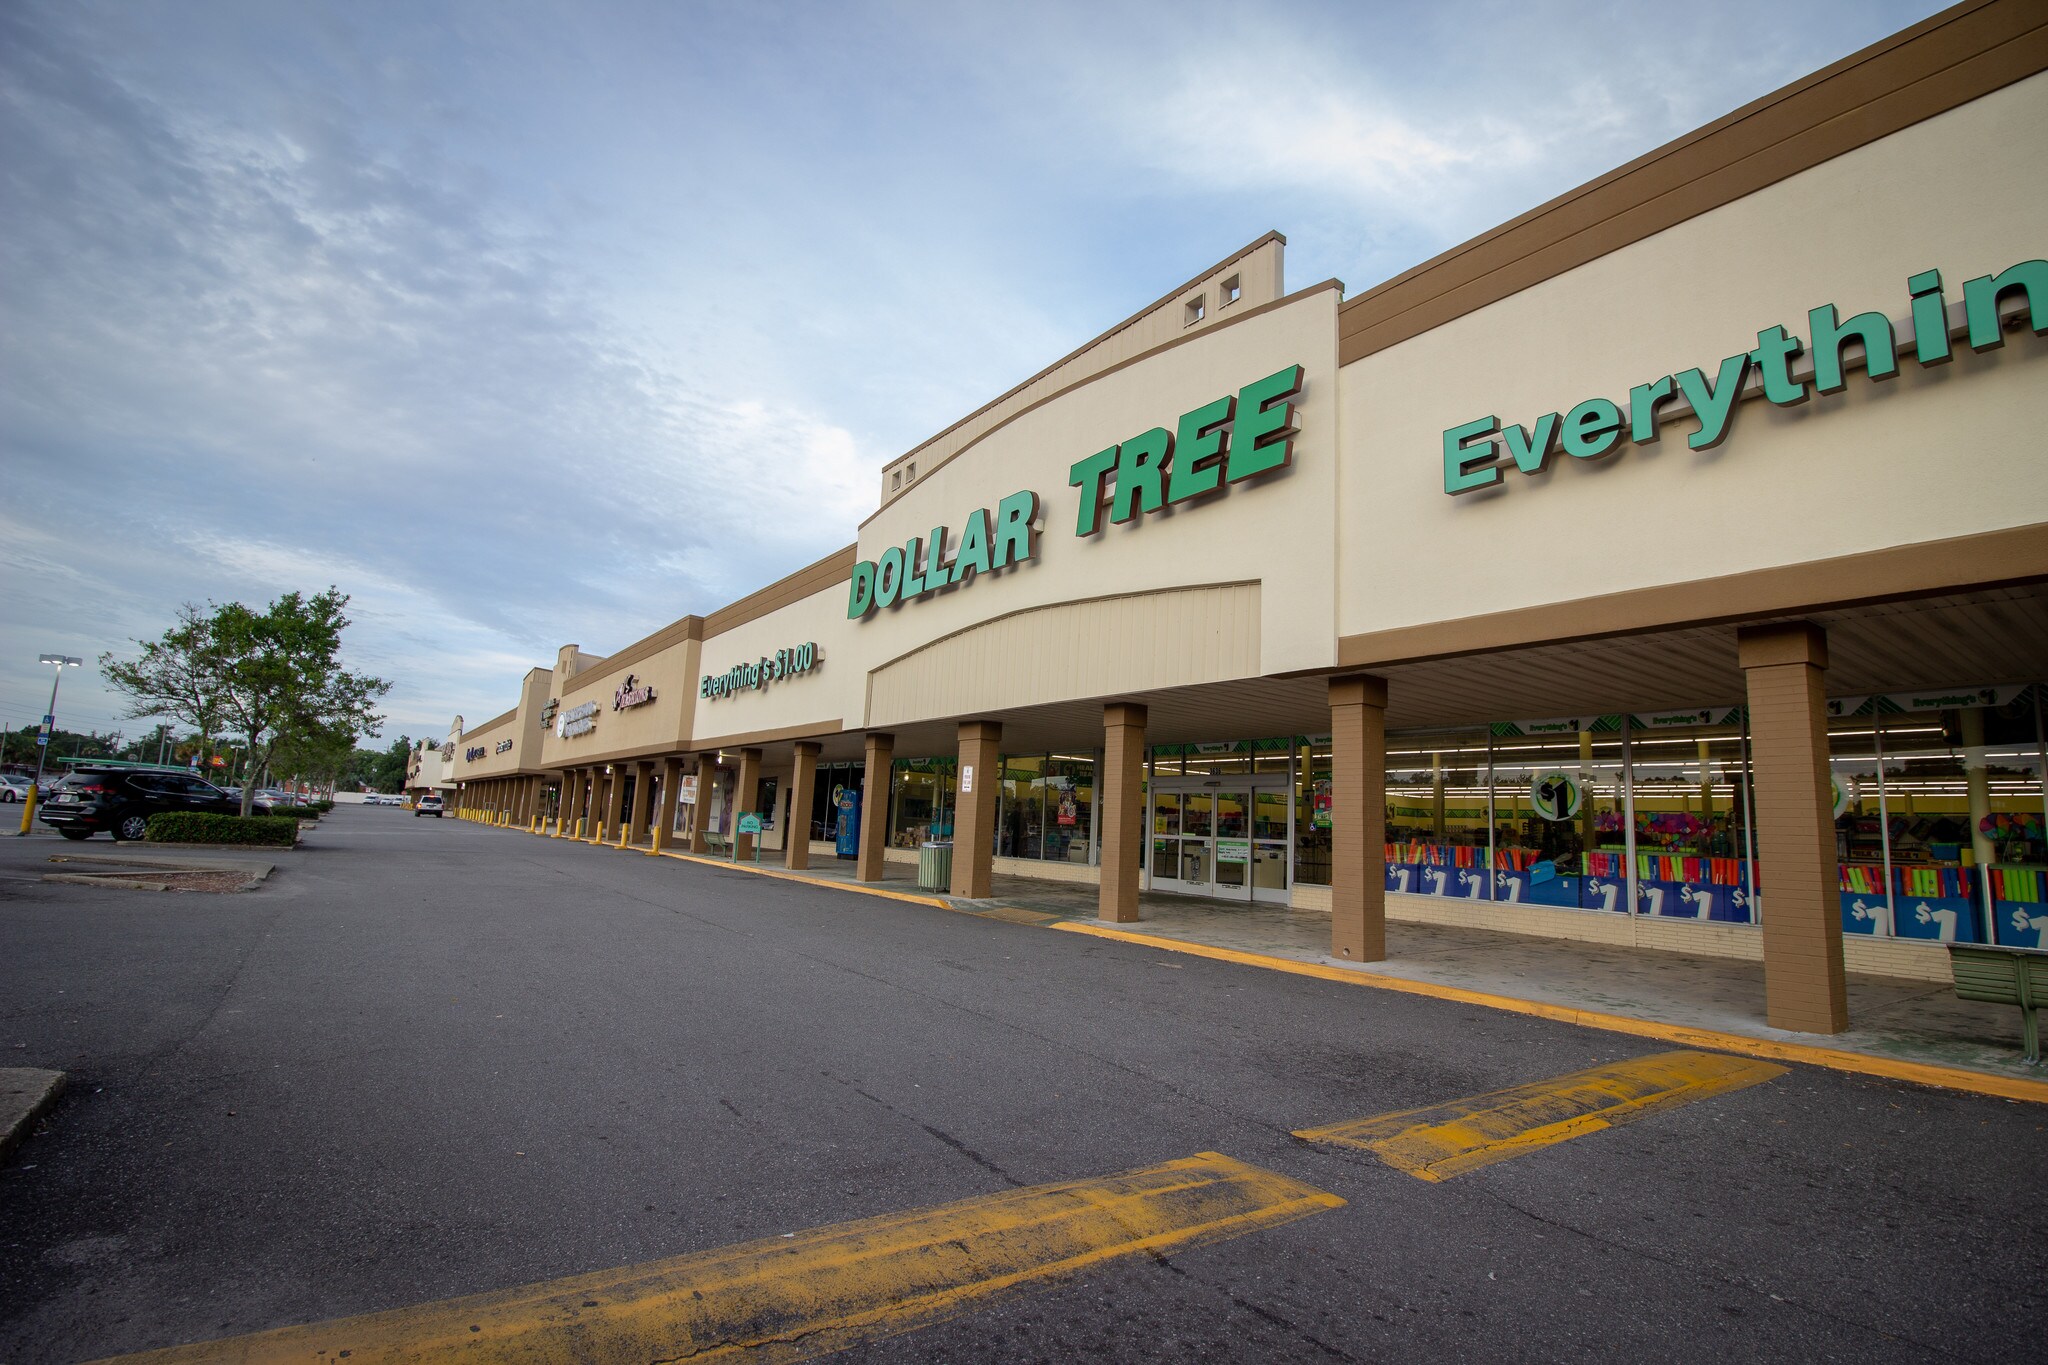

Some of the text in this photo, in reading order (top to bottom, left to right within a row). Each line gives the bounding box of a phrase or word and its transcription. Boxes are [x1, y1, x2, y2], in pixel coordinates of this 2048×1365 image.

[1443, 260, 2048, 495] Everythin
[848, 364, 1304, 620] DOLLAR TREE
[700, 656, 774, 698] Everything's
[774, 641, 818, 680] $1.00
[1652, 710, 1712, 727] Everything's $1
[1912, 694, 1976, 709] Everything's
[1529, 722, 1568, 733] Everything's
[1540, 780, 1571, 820] $1
[1389, 864, 1410, 892] $1
[1424, 866, 1447, 896] $1
[1458, 869, 1483, 899] $1
[1496, 871, 1522, 902] $1
[1588, 877, 1618, 911] $1
[1680, 884, 1713, 920] $1
[1851, 899, 1889, 936] $1
[1914, 901, 1958, 942] $1
